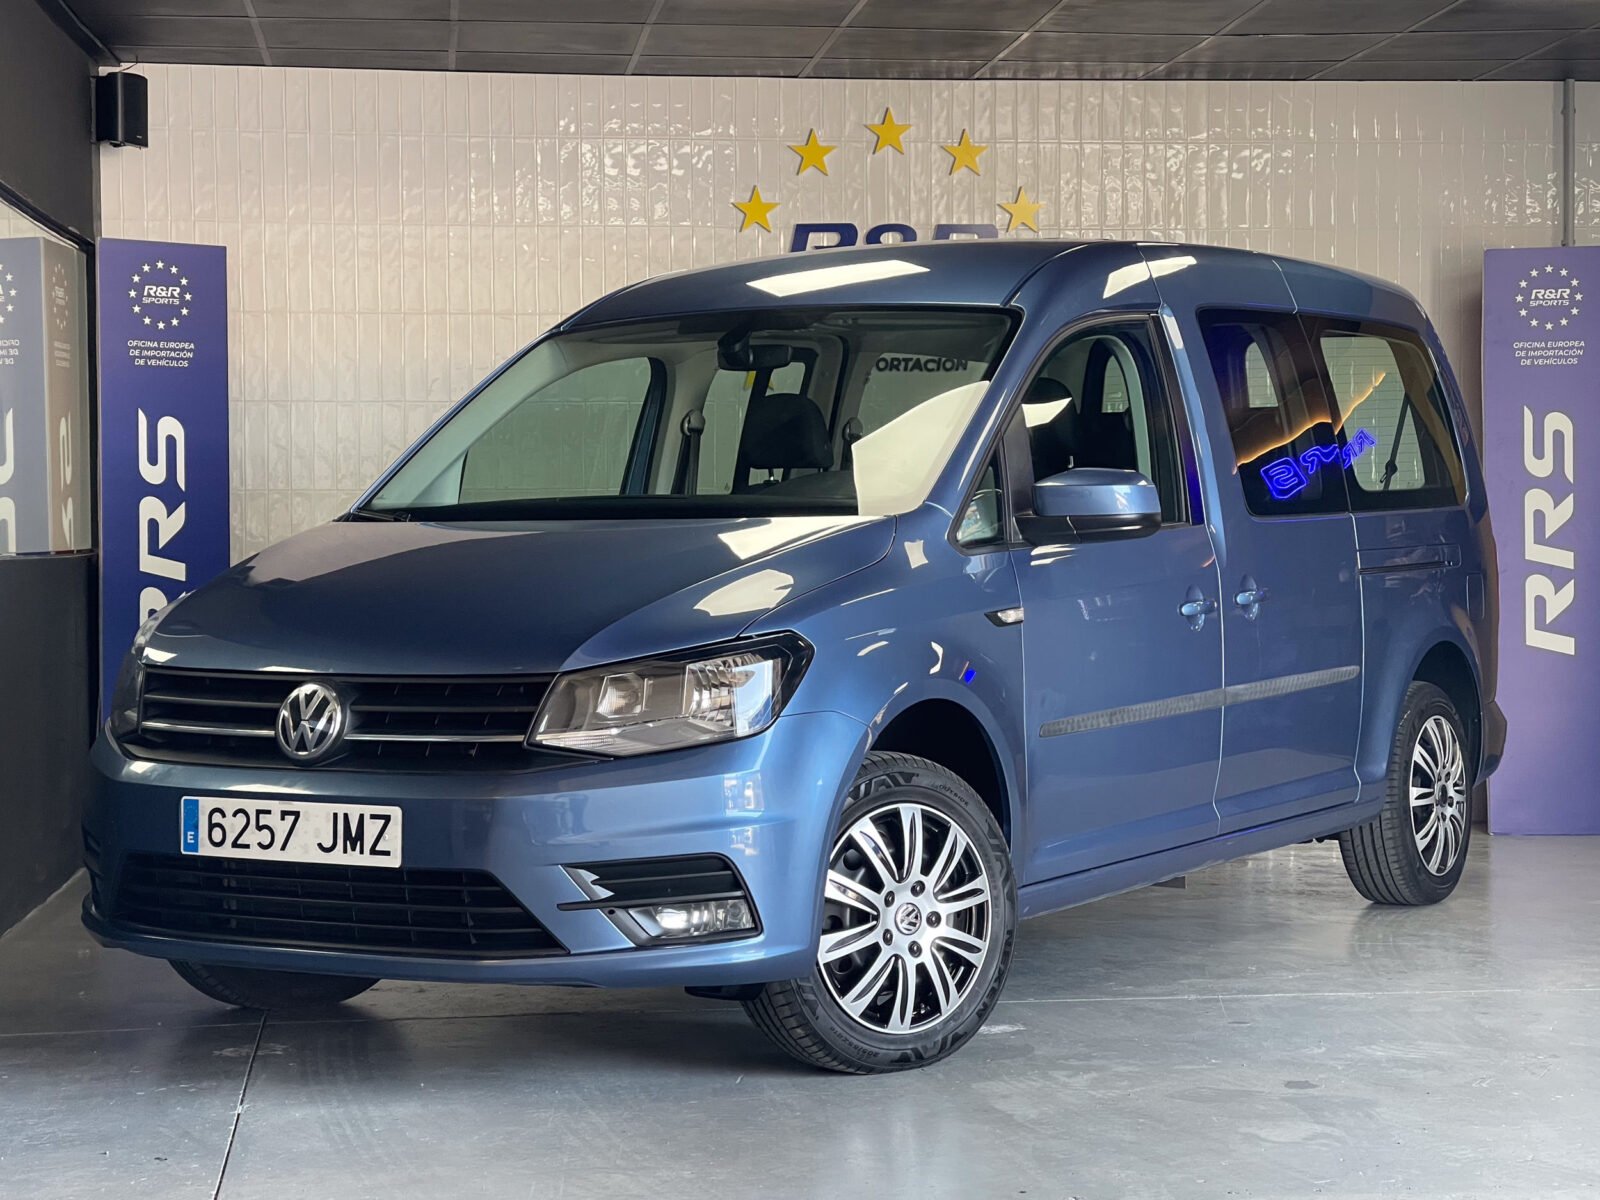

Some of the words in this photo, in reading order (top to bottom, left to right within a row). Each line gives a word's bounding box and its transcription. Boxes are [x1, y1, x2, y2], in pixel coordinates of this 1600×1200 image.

[143, 285, 181, 298] R&R
[1531, 289, 1571, 300] R&R
[142, 296, 181, 305] SPORTS
[1529, 299, 1570, 307] SPORTS
[127, 340, 158, 349] OFICINA
[159, 341, 195, 350] EUROPEA
[1513, 341, 1546, 349] OFICINA
[1548, 340, 1585, 348] EUROPEA
[129, 349, 141, 357] DE
[141, 350, 193, 359] IMPORTACIÓN
[1528, 348, 1584, 357] IMPORTACIÓN
[134, 358, 146, 366] DE
[147, 358, 189, 368] VEHÍCULOS
[1534, 357, 1579, 366] VEHÍCULOS
[1524, 405, 1575, 656] RRS
[187, 831, 195, 843] E
[207, 806, 301, 851] 6257
[316, 811, 392, 857] JMZ
[976, 928, 1013, 1018] NEXEN
